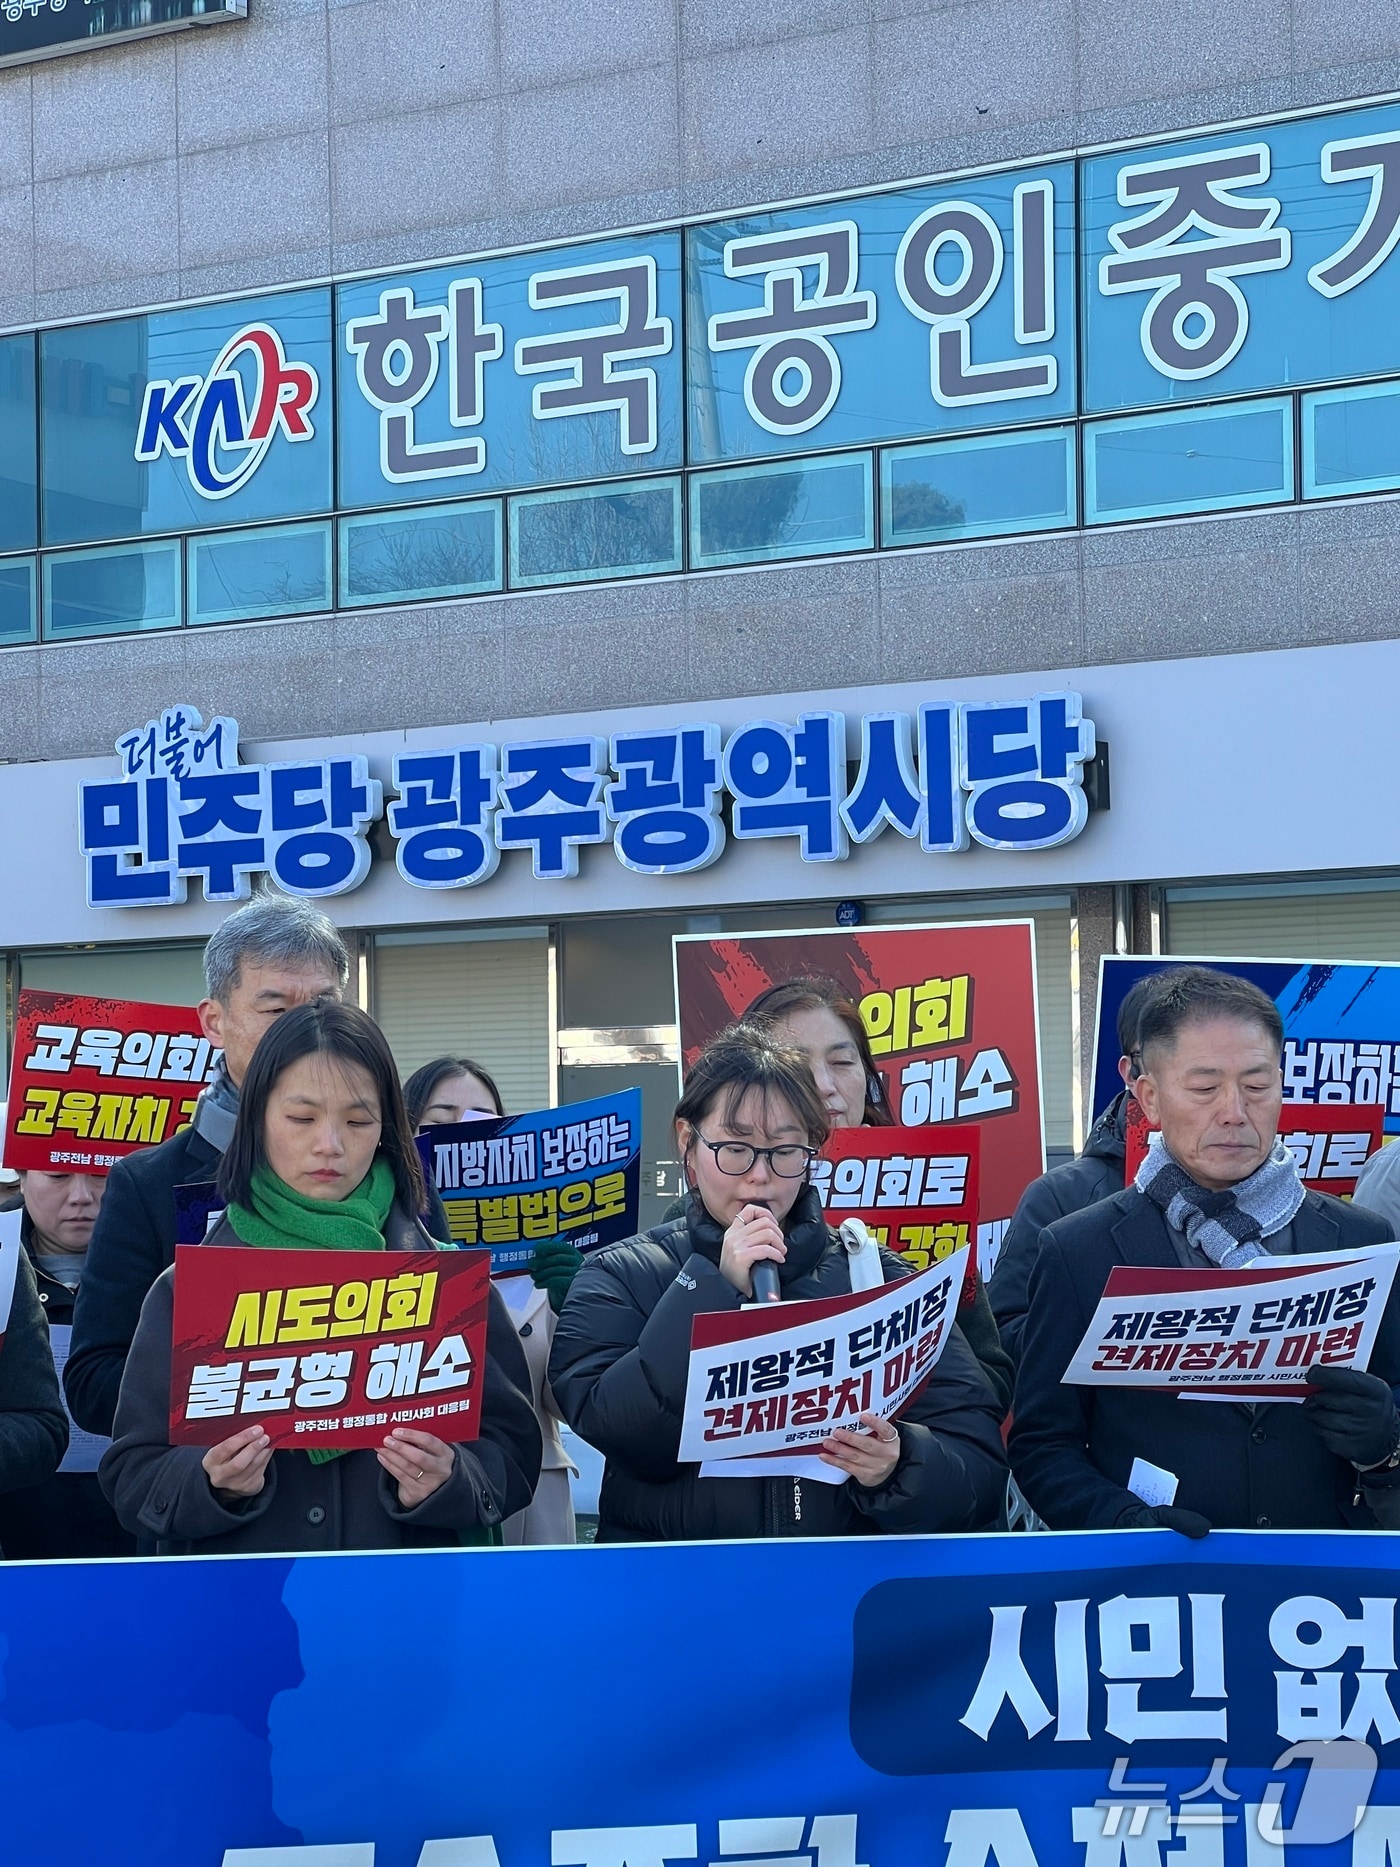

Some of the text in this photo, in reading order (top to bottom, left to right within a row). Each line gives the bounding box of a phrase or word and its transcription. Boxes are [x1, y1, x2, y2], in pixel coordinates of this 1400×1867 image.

[134, 322, 320, 500] KAR
[119, 709, 225, 782] 더불어
[81, 697, 1082, 903] 민주당 광주광역시당
[839, 909, 855, 920] ADT
[858, 975, 969, 1056] 의회
[16, 1088, 170, 1144] 교육자치
[901, 1048, 1012, 1127] 해소
[50, 1151, 124, 1167] 광주전남 행정
[434, 1114, 630, 1190] 지방자치 보장하는
[806, 1156, 969, 1208] 의회로
[224, 1271, 439, 1349] 시도의회
[704, 1275, 953, 1402] 제왕적 단체장
[1091, 1321, 1365, 1371] 견제장치 마련
[1102, 1277, 1377, 1341] 제왕적 단체장
[185, 1333, 473, 1420] 불균형 해소
[703, 1318, 945, 1443] 견제장치 마련
[1267, 1371, 1306, 1381] 시민사
[293, 1418, 340, 1433] 광주전남
[342, 1412, 388, 1430] 행정통합
[390, 1406, 434, 1423] 시민사회
[785, 1427, 833, 1443] 광주전남
[958, 1592, 1229, 1745] 시민
